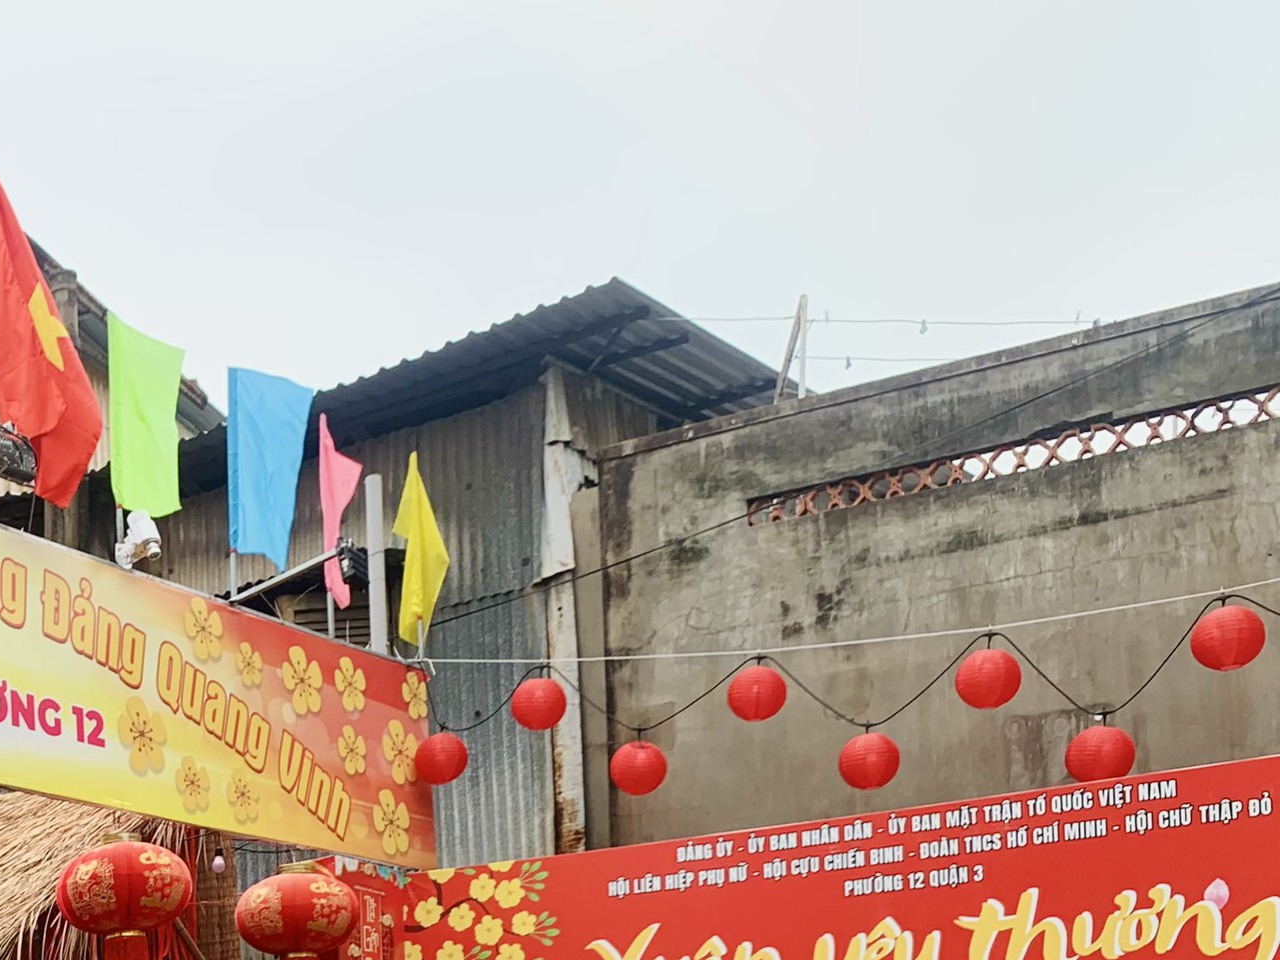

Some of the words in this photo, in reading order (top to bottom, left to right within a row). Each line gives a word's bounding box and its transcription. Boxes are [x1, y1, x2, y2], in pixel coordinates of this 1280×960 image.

[40, 578, 146, 689] Đảng
[156, 640, 271, 773] Quang
[278, 727, 351, 842] Vinh
[71, 705, 106, 748] 12
[608, 876, 630, 898] HỘI
[633, 873, 661, 894] LIÊN
[665, 869, 695, 892] HIỆP
[698, 868, 725, 887] PHỤ
[728, 862, 749, 883] NỮ
[763, 858, 787, 881] HỘI
[791, 856, 820, 878] CỰU
[824, 848, 865, 871] CHIẾN
[870, 845, 904, 865] BINH
[919, 836, 959, 859] ĐOÀN
[964, 832, 1002, 853] TNCS
[1032, 820, 1059, 845] CHÍ
[1063, 819, 1107, 840] MINH
[1125, 810, 1153, 835] HỘI
[1158, 804, 1193, 828] CHỮ
[1198, 799, 1242, 824] THẬP
[1248, 792, 1272, 817] ĐỎ
[676, 840, 713, 862] ĐẢNG
[716, 837, 734, 858] ỦY
[747, 833, 765, 854] ỦY
[769, 832, 797, 851] BAN
[801, 824, 839, 847] NHÂN
[844, 819, 873, 841] DÂN
[888, 813, 906, 835] ỦY
[911, 813, 941, 832] BAN
[945, 805, 978, 829] MẶT
[982, 800, 1022, 823] TRẬN
[1051, 788, 1093, 813] QUỐC
[1098, 783, 1133, 808] VIỆT
[1138, 780, 1177, 801] NAM
[844, 872, 904, 897] PHƯỜNG
[907, 871, 925, 889] 12
[929, 864, 968, 888] QUẬN
[973, 864, 984, 882] 3
